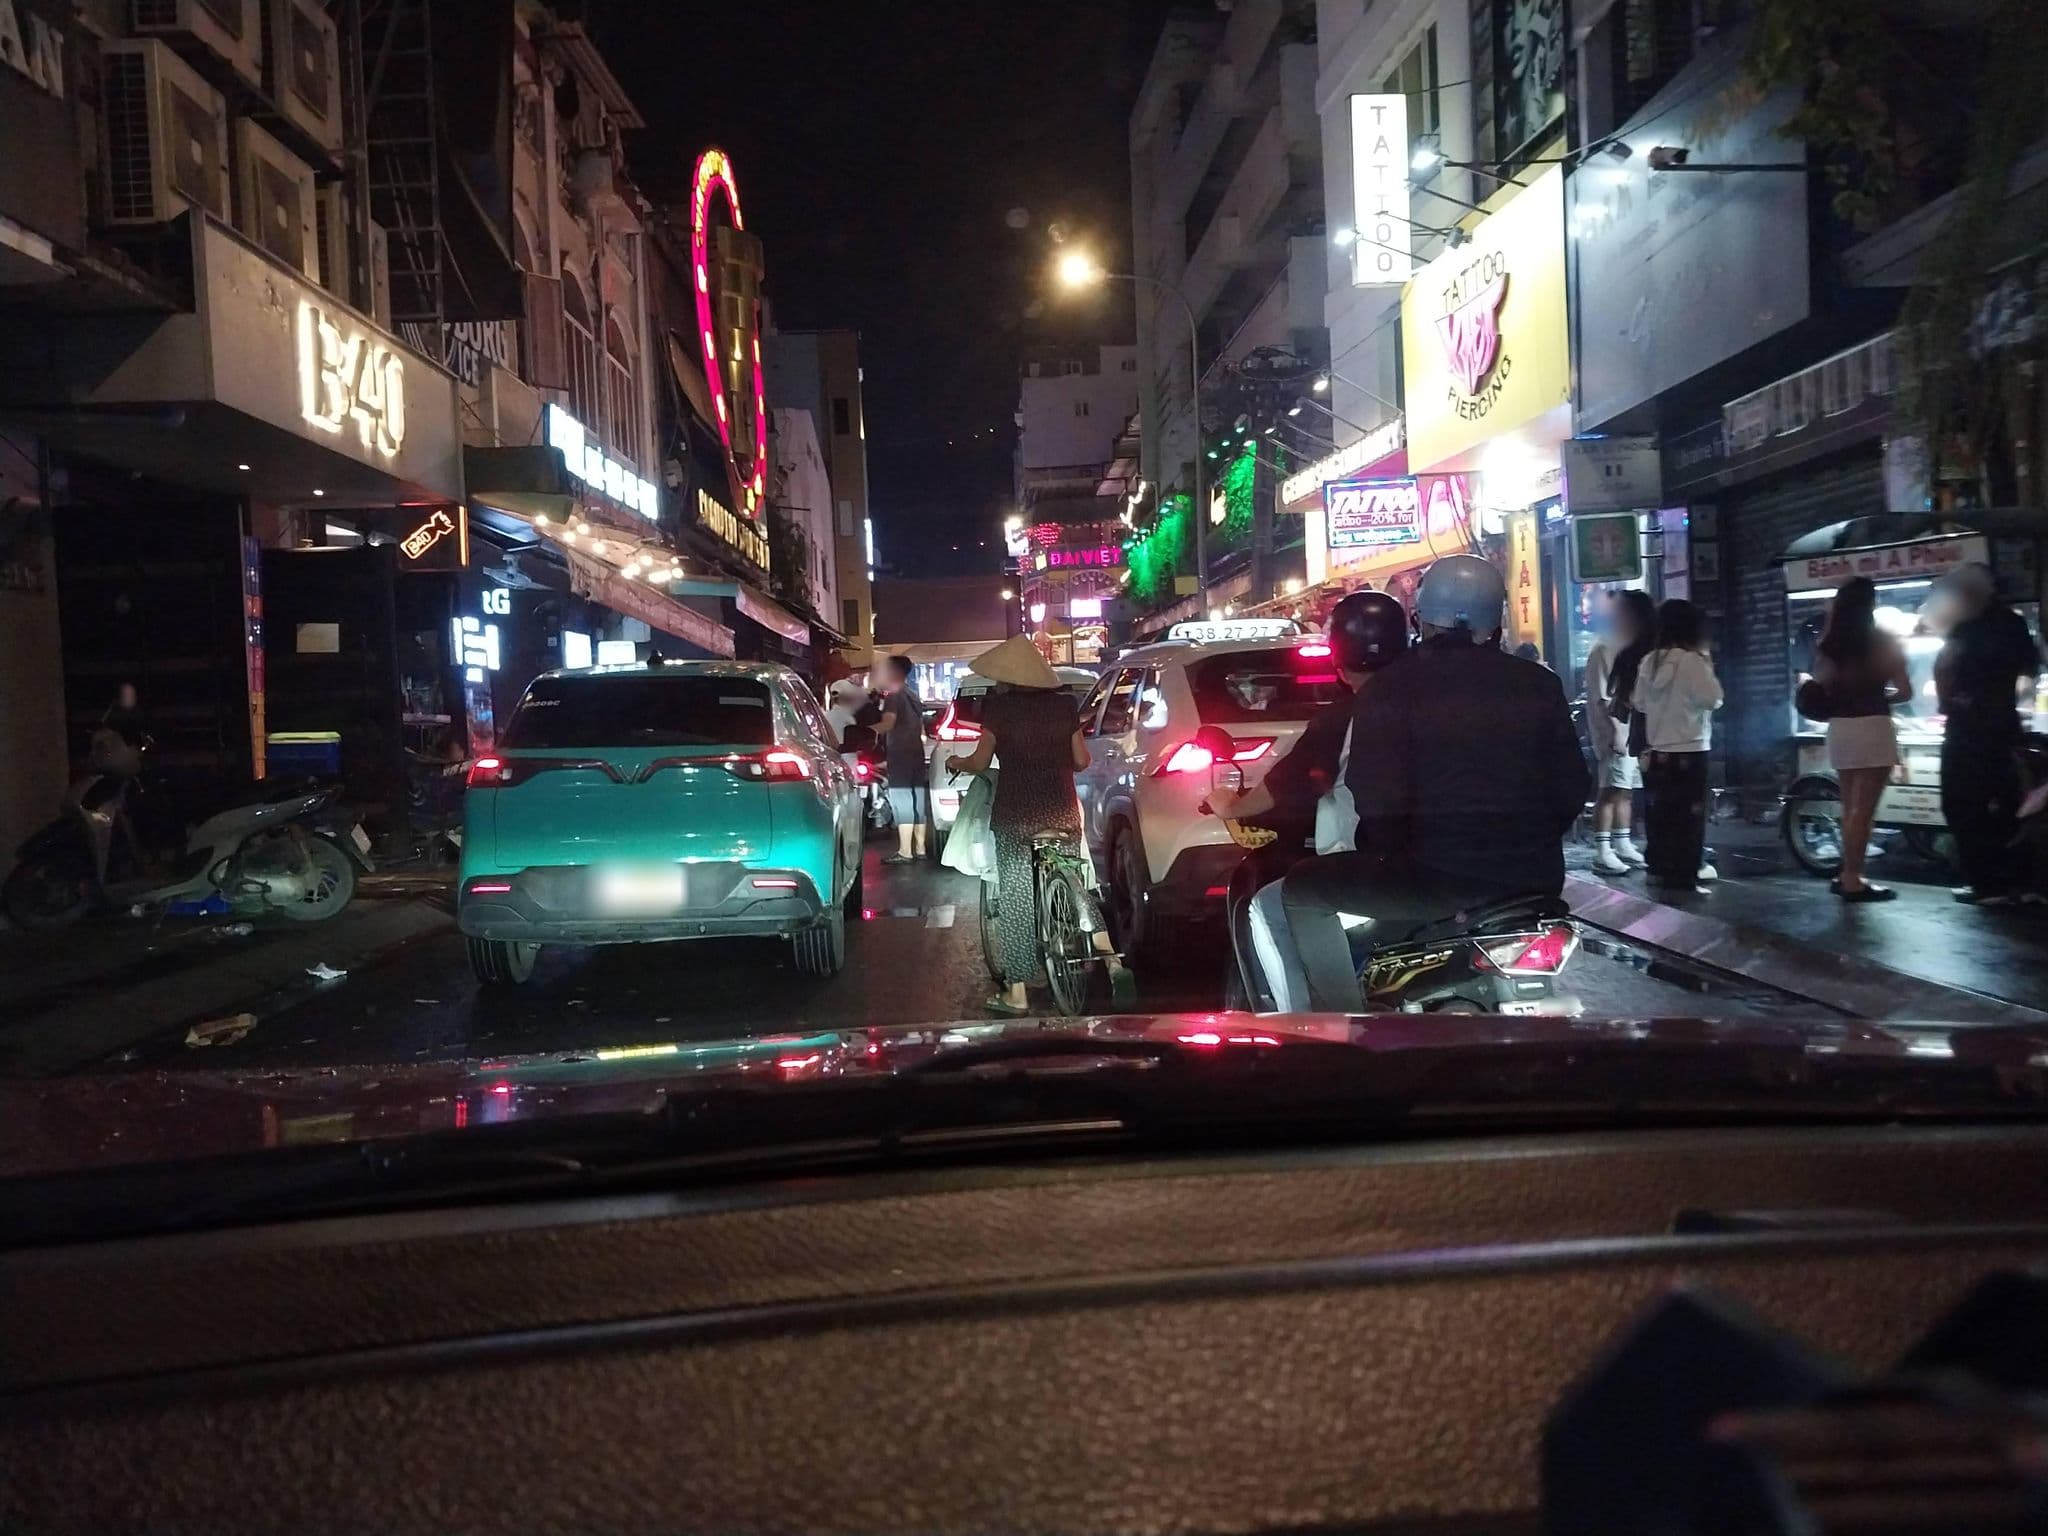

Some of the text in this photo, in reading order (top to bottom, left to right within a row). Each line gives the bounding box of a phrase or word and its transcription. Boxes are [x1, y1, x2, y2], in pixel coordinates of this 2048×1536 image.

[1370, 105, 1393, 272] TATTOO
[1442, 250, 1505, 314] TATTOO
[300, 302, 405, 457] B40
[1447, 354, 1512, 422] PIERCING
